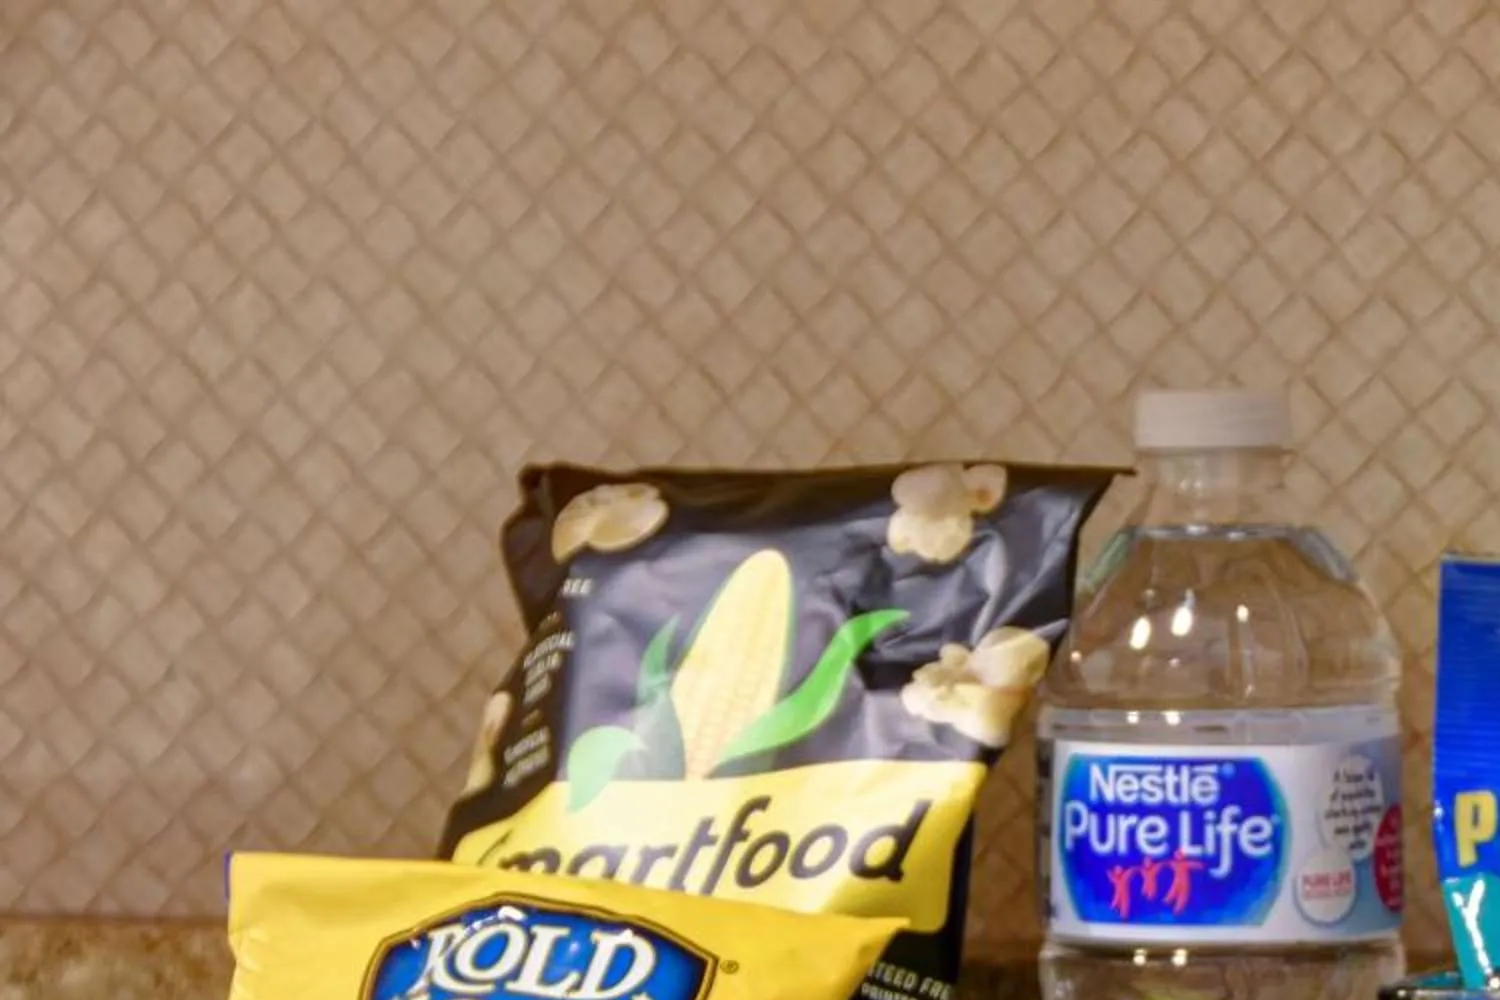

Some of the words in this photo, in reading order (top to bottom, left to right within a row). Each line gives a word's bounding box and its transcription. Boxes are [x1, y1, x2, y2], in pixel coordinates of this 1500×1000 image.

[1089, 763, 1220, 806] Nestlé
[479, 795, 934, 897] martfood
[1065, 801, 1169, 858] Pure
[1179, 804, 1273, 880] Life
